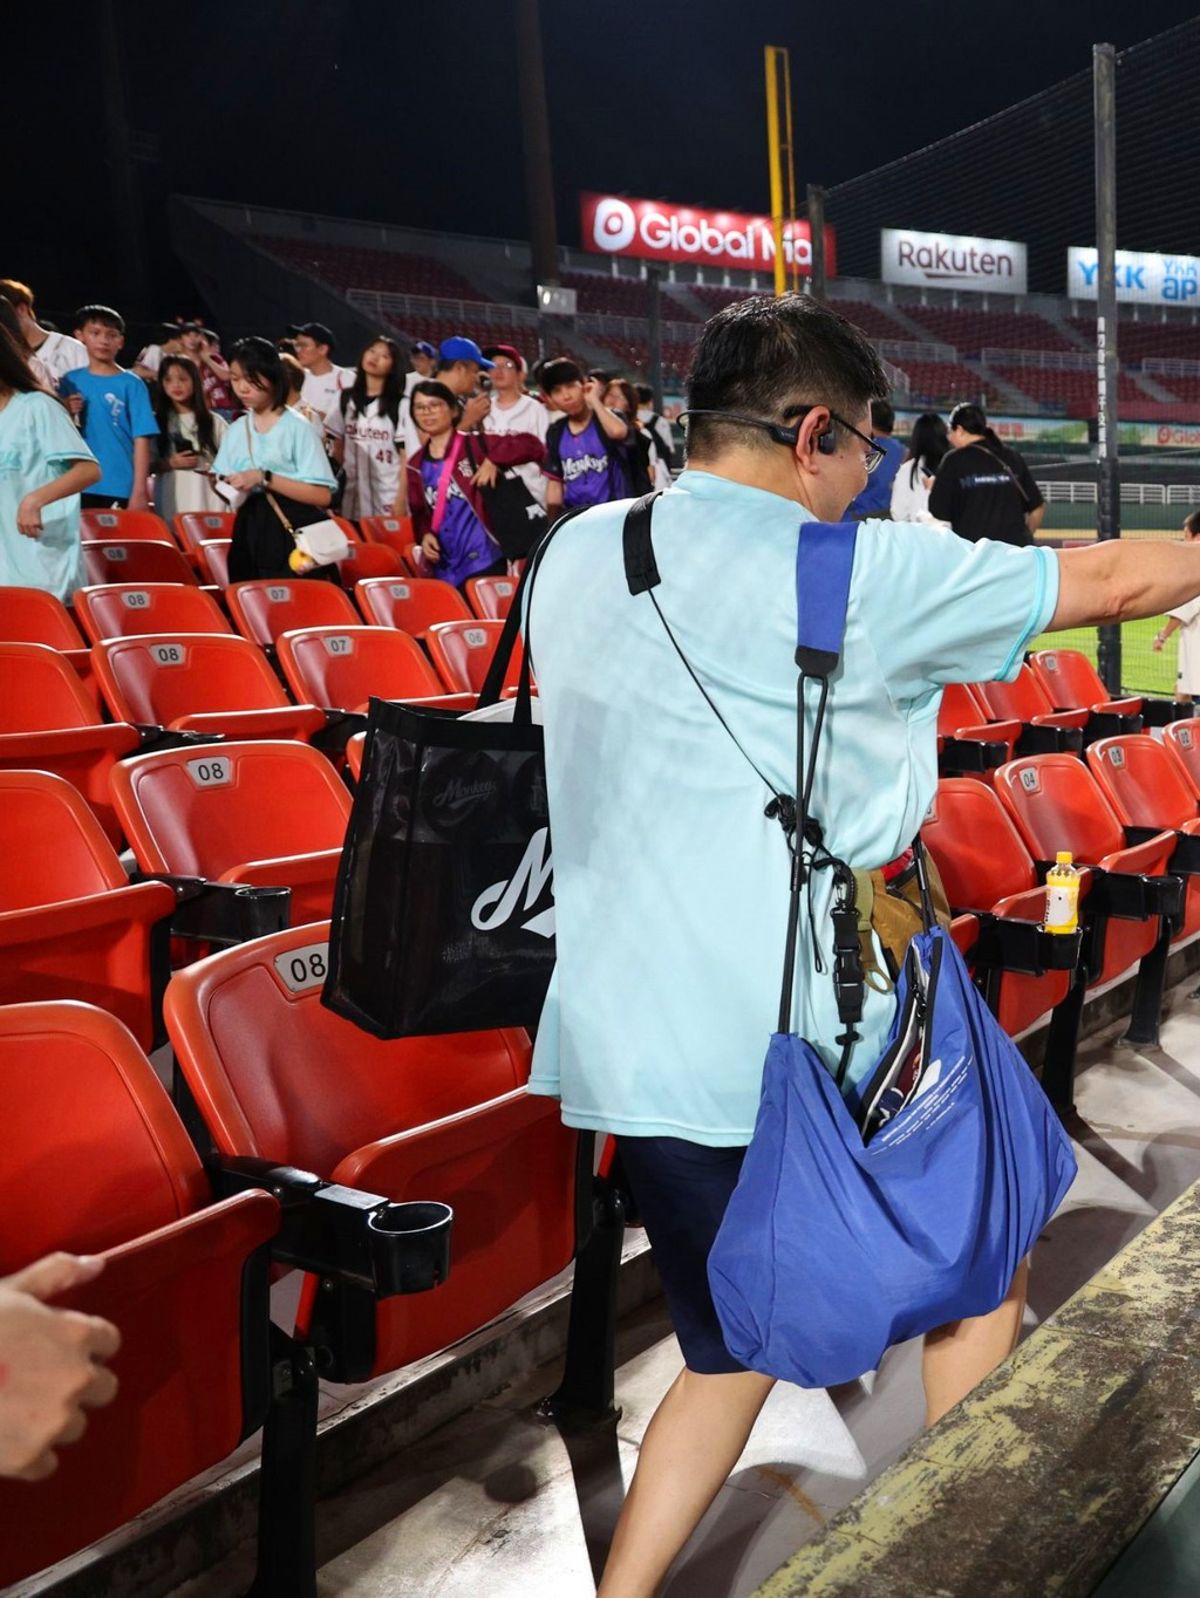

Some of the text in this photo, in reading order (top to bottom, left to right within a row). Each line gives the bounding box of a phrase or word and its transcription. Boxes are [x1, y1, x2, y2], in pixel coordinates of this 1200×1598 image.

[640, 212, 811, 265] Global Ma
[899, 241, 1013, 276] Rakuten
[1078, 261, 1147, 290] YK
[1163, 260, 1198, 277] YKK
[1162, 277, 1198, 300] ap
[127, 595, 145, 606] 08
[158, 648, 179, 661] 08
[330, 639, 346, 652] 07
[198, 763, 224, 781] 08
[1023, 771, 1036, 788] 04
[291, 953, 326, 983] 08
